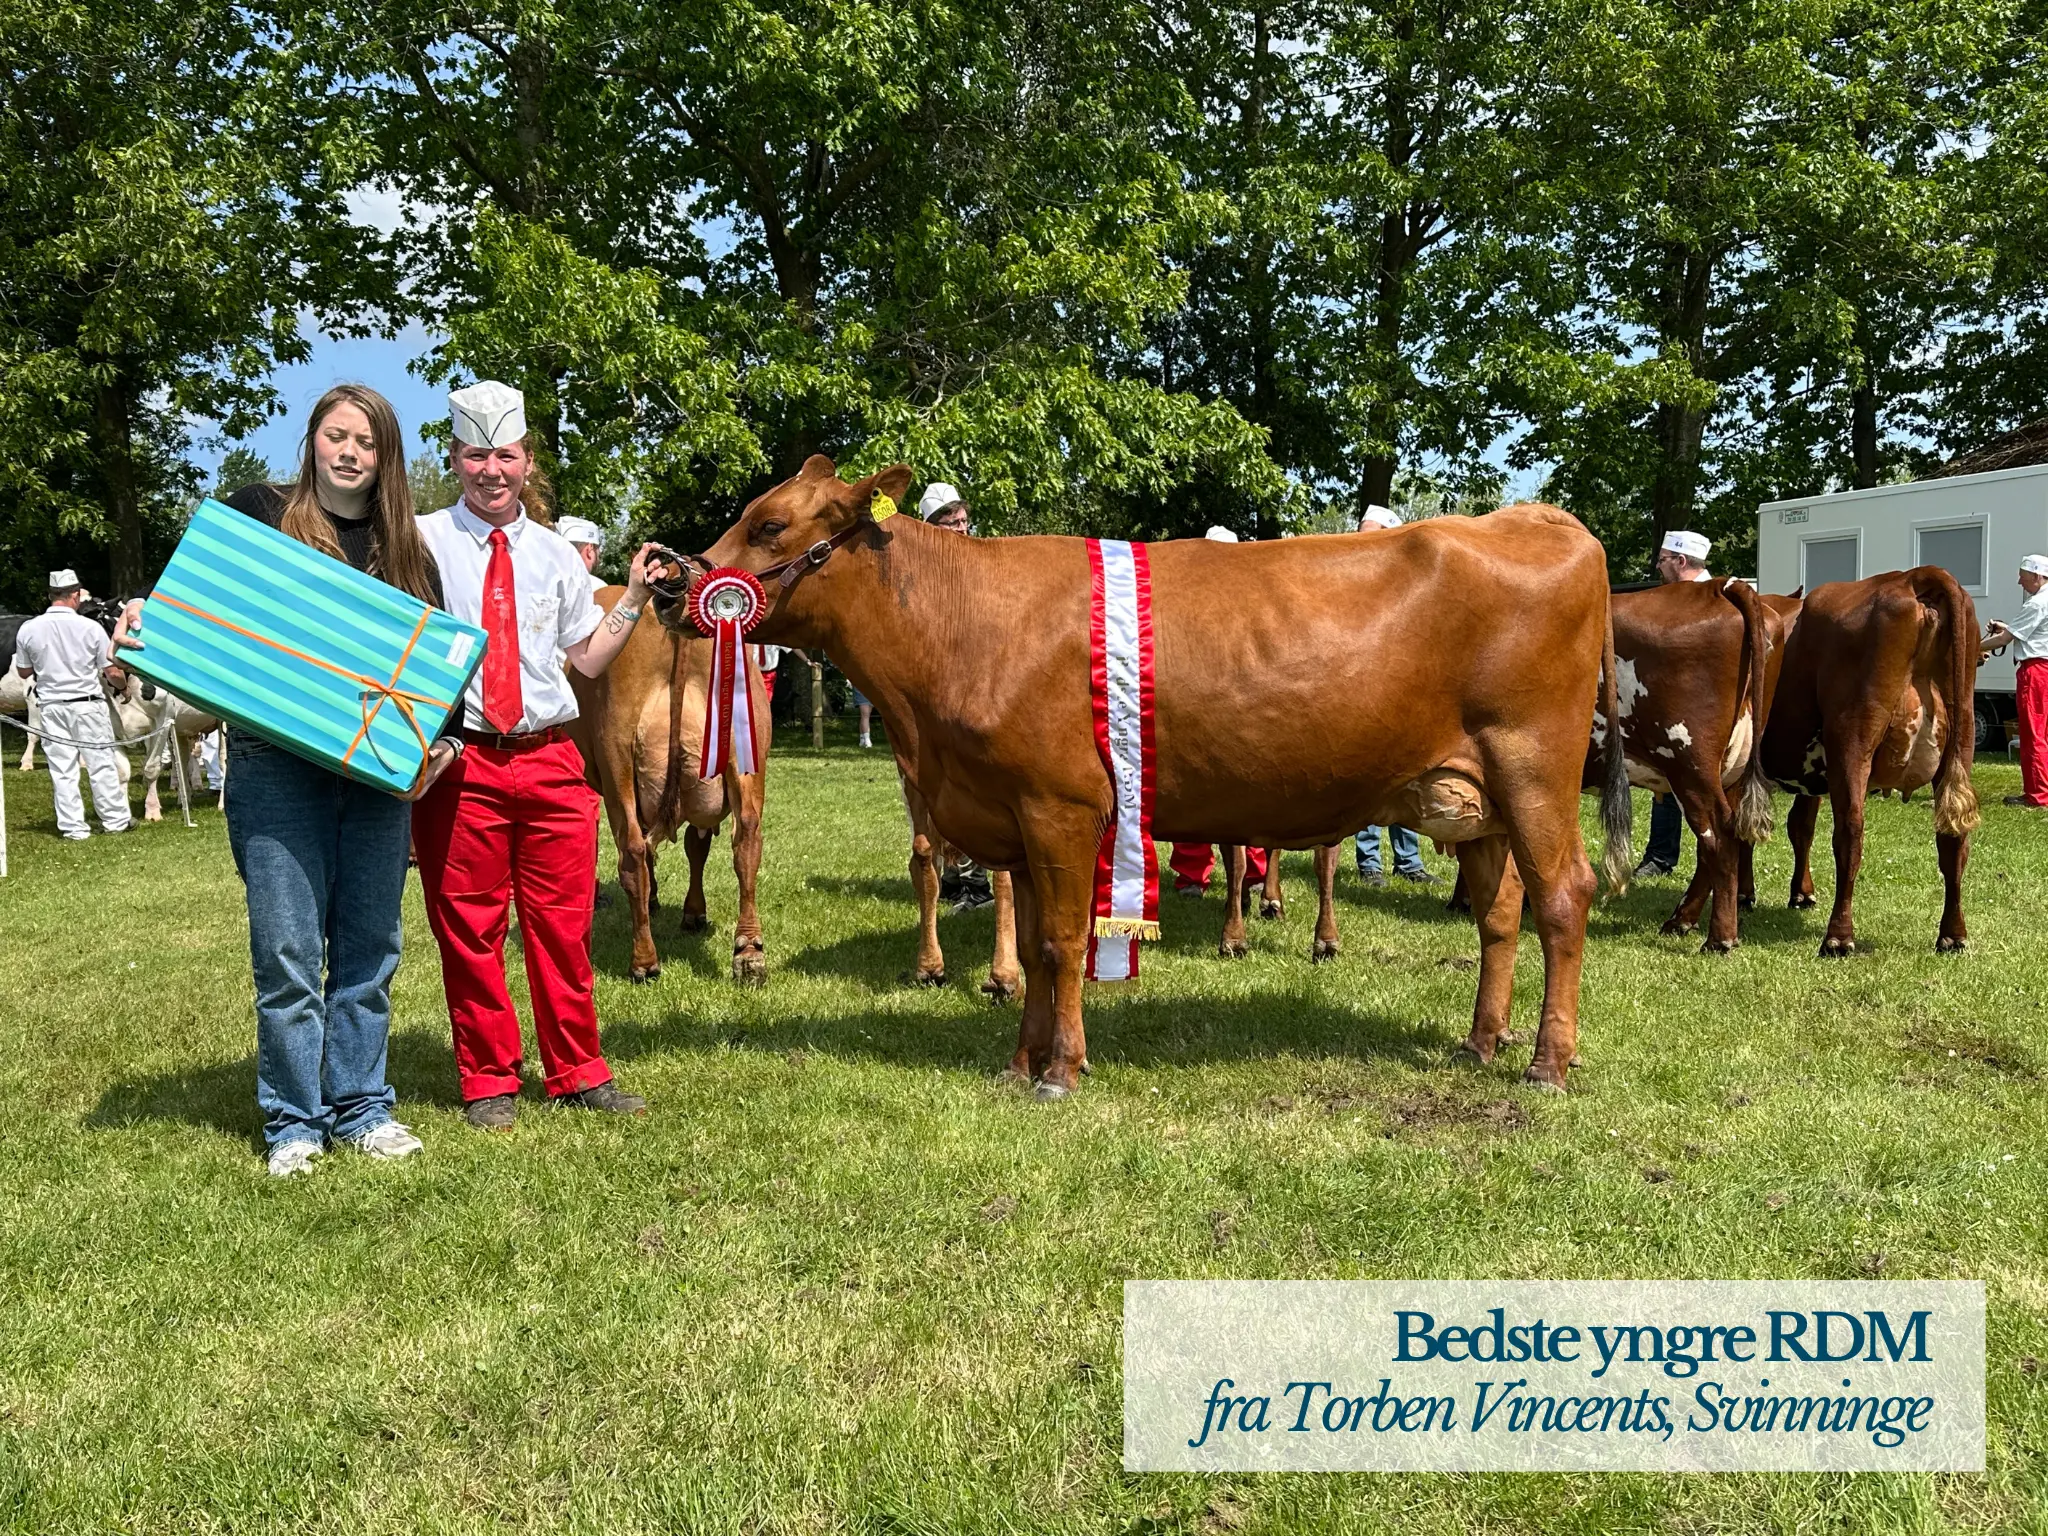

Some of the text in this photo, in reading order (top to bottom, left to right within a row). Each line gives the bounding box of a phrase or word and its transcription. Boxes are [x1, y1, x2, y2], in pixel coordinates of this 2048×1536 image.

[724, 641, 732, 672] Bedste
[722, 674, 732, 700] Yngre
[722, 704, 730, 727] RDM
